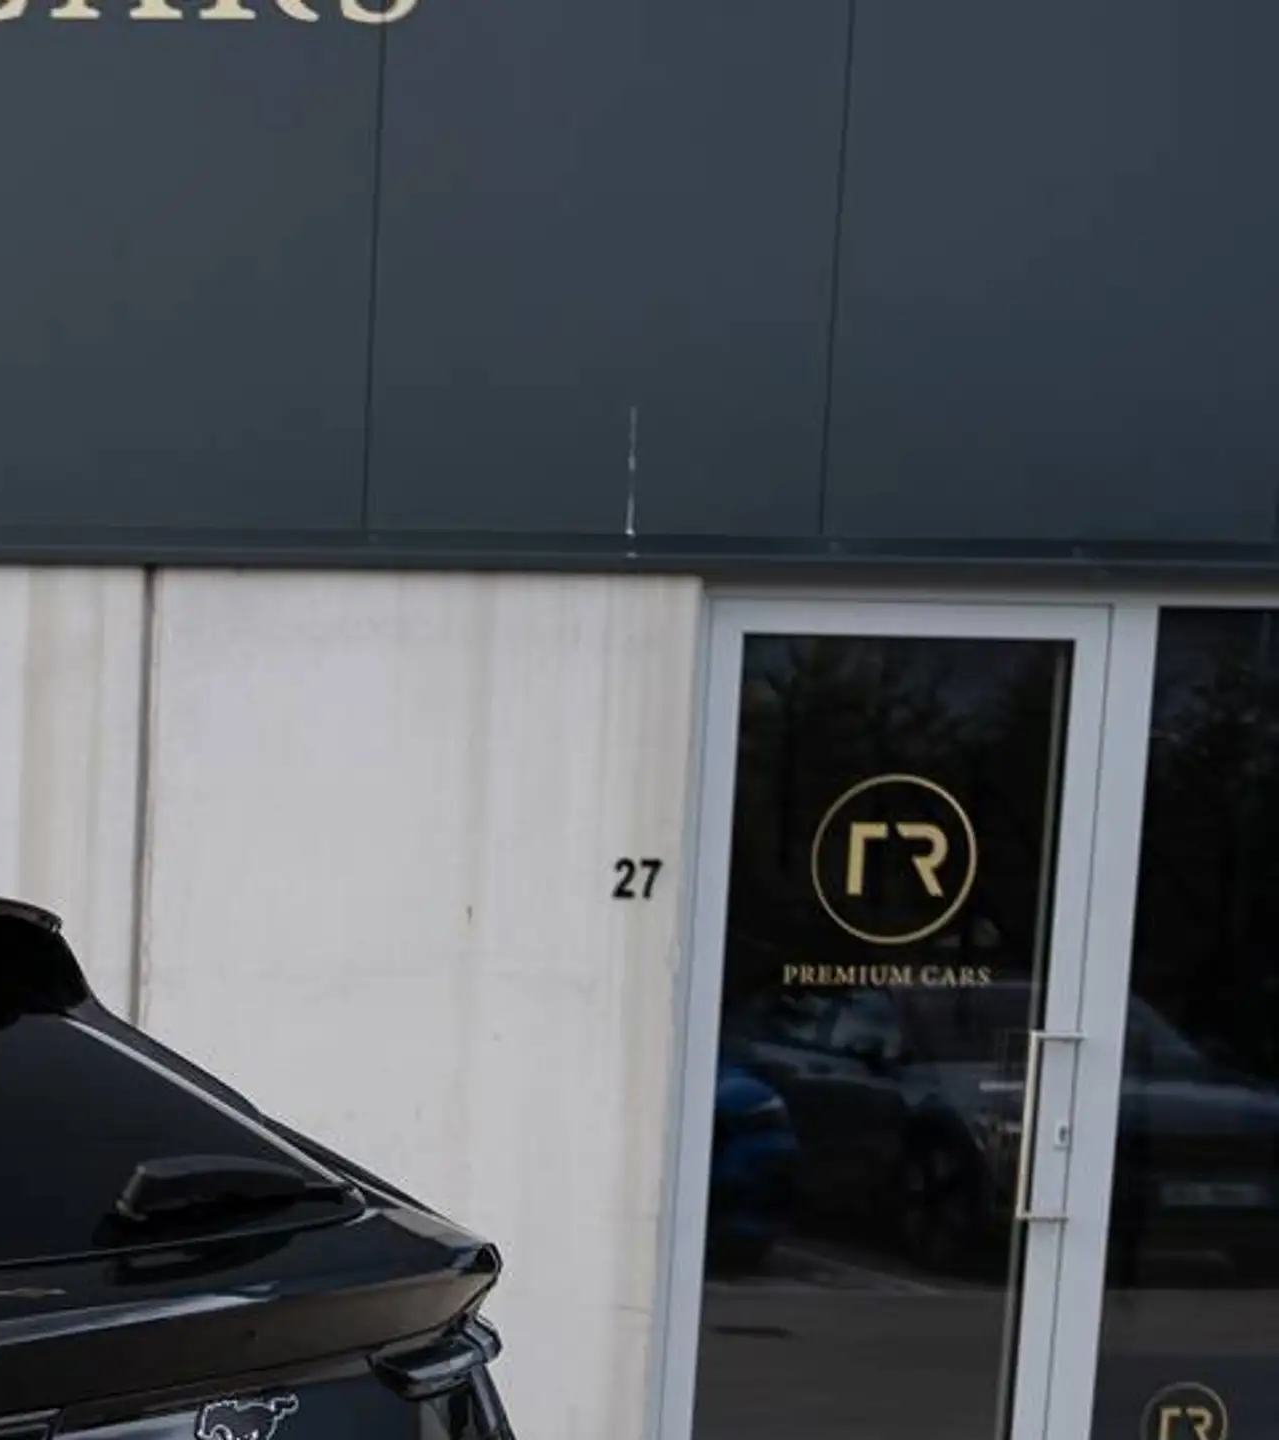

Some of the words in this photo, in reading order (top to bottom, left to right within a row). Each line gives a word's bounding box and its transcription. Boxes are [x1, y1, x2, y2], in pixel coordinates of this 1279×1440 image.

[613, 857, 662, 900] 27
[782, 963, 913, 986] PREMIUM
[920, 964, 992, 987] CARS
